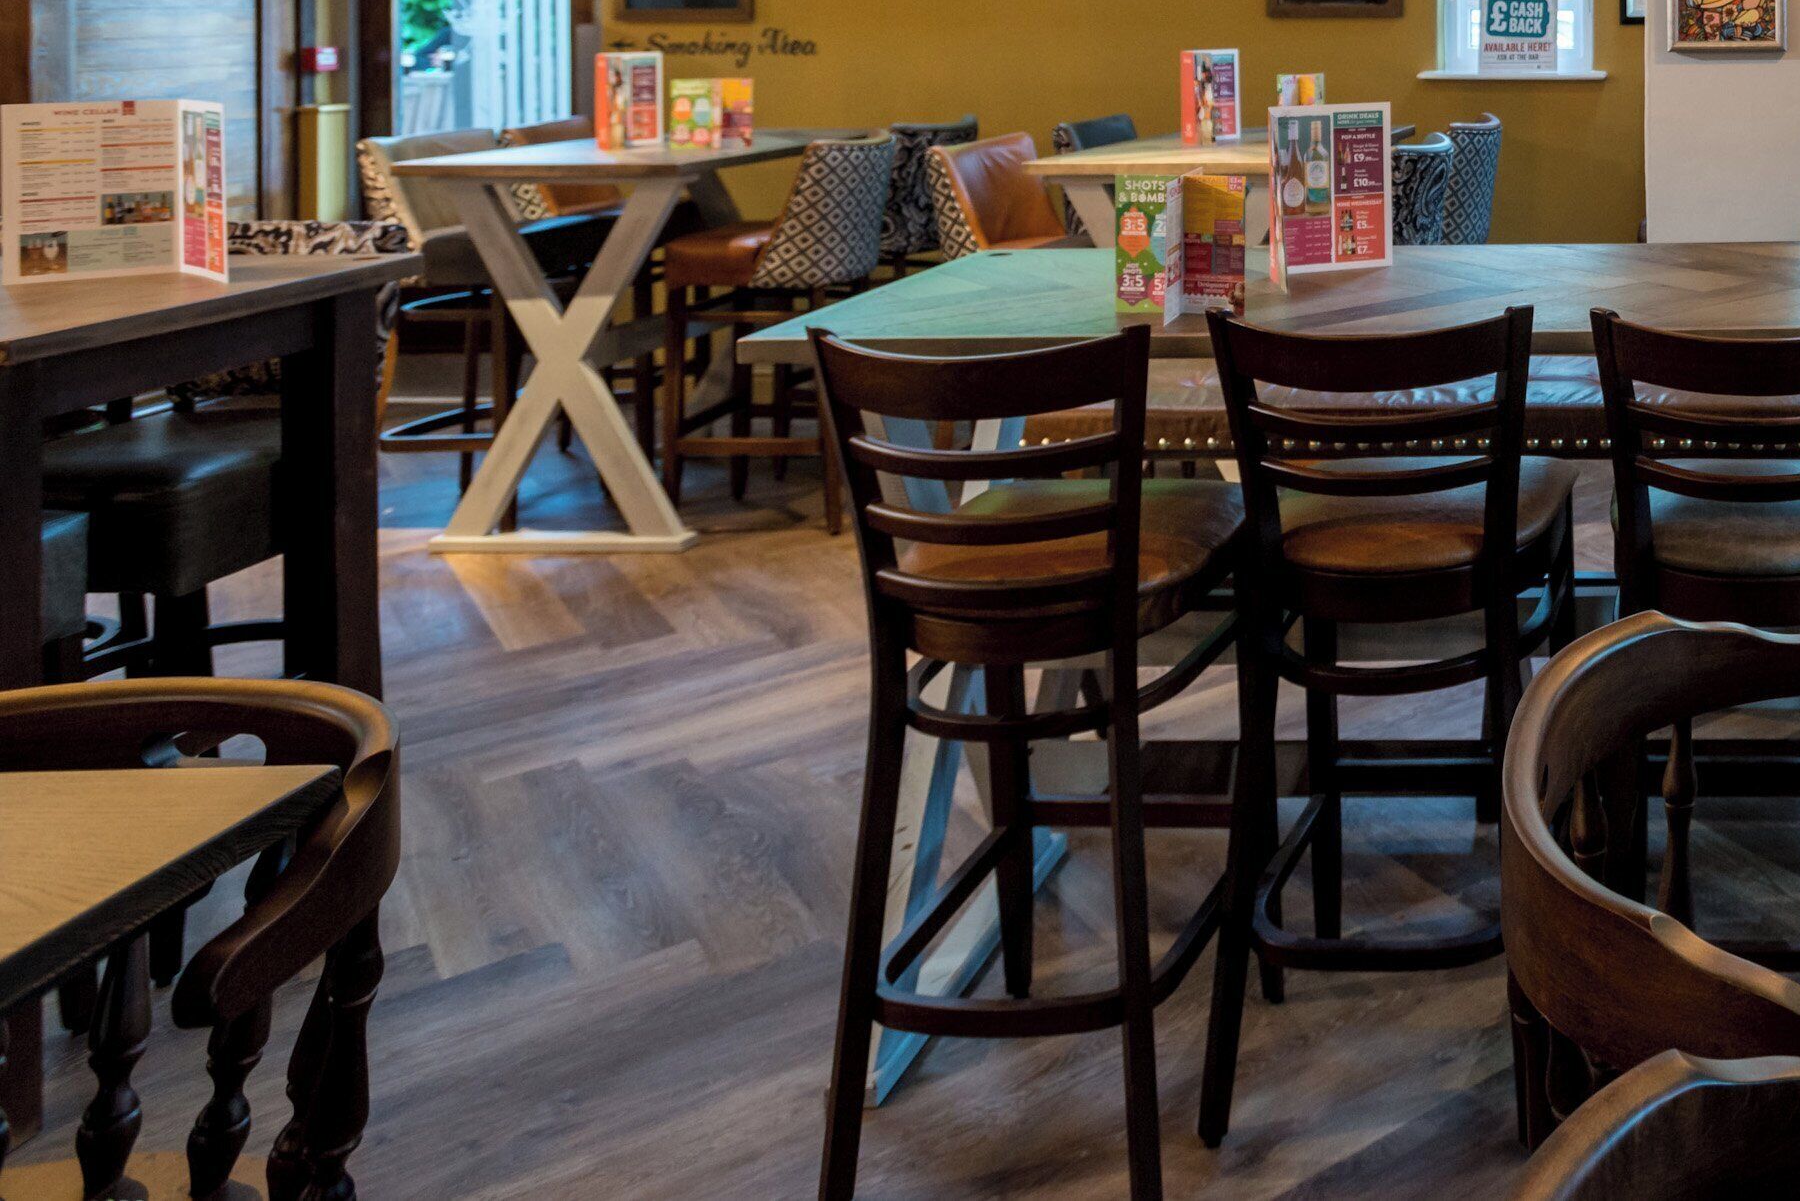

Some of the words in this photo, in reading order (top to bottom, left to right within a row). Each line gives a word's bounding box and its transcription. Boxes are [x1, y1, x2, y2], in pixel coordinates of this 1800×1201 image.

[1509, 1, 1544, 17] CASH
[1509, 18, 1543, 33] BACK
[648, 30, 751, 69] Smoking
[1484, 42, 1525, 53] AVAILABLE
[1125, 180, 1166, 190] SHOTS
[1118, 192, 1127, 202] &
